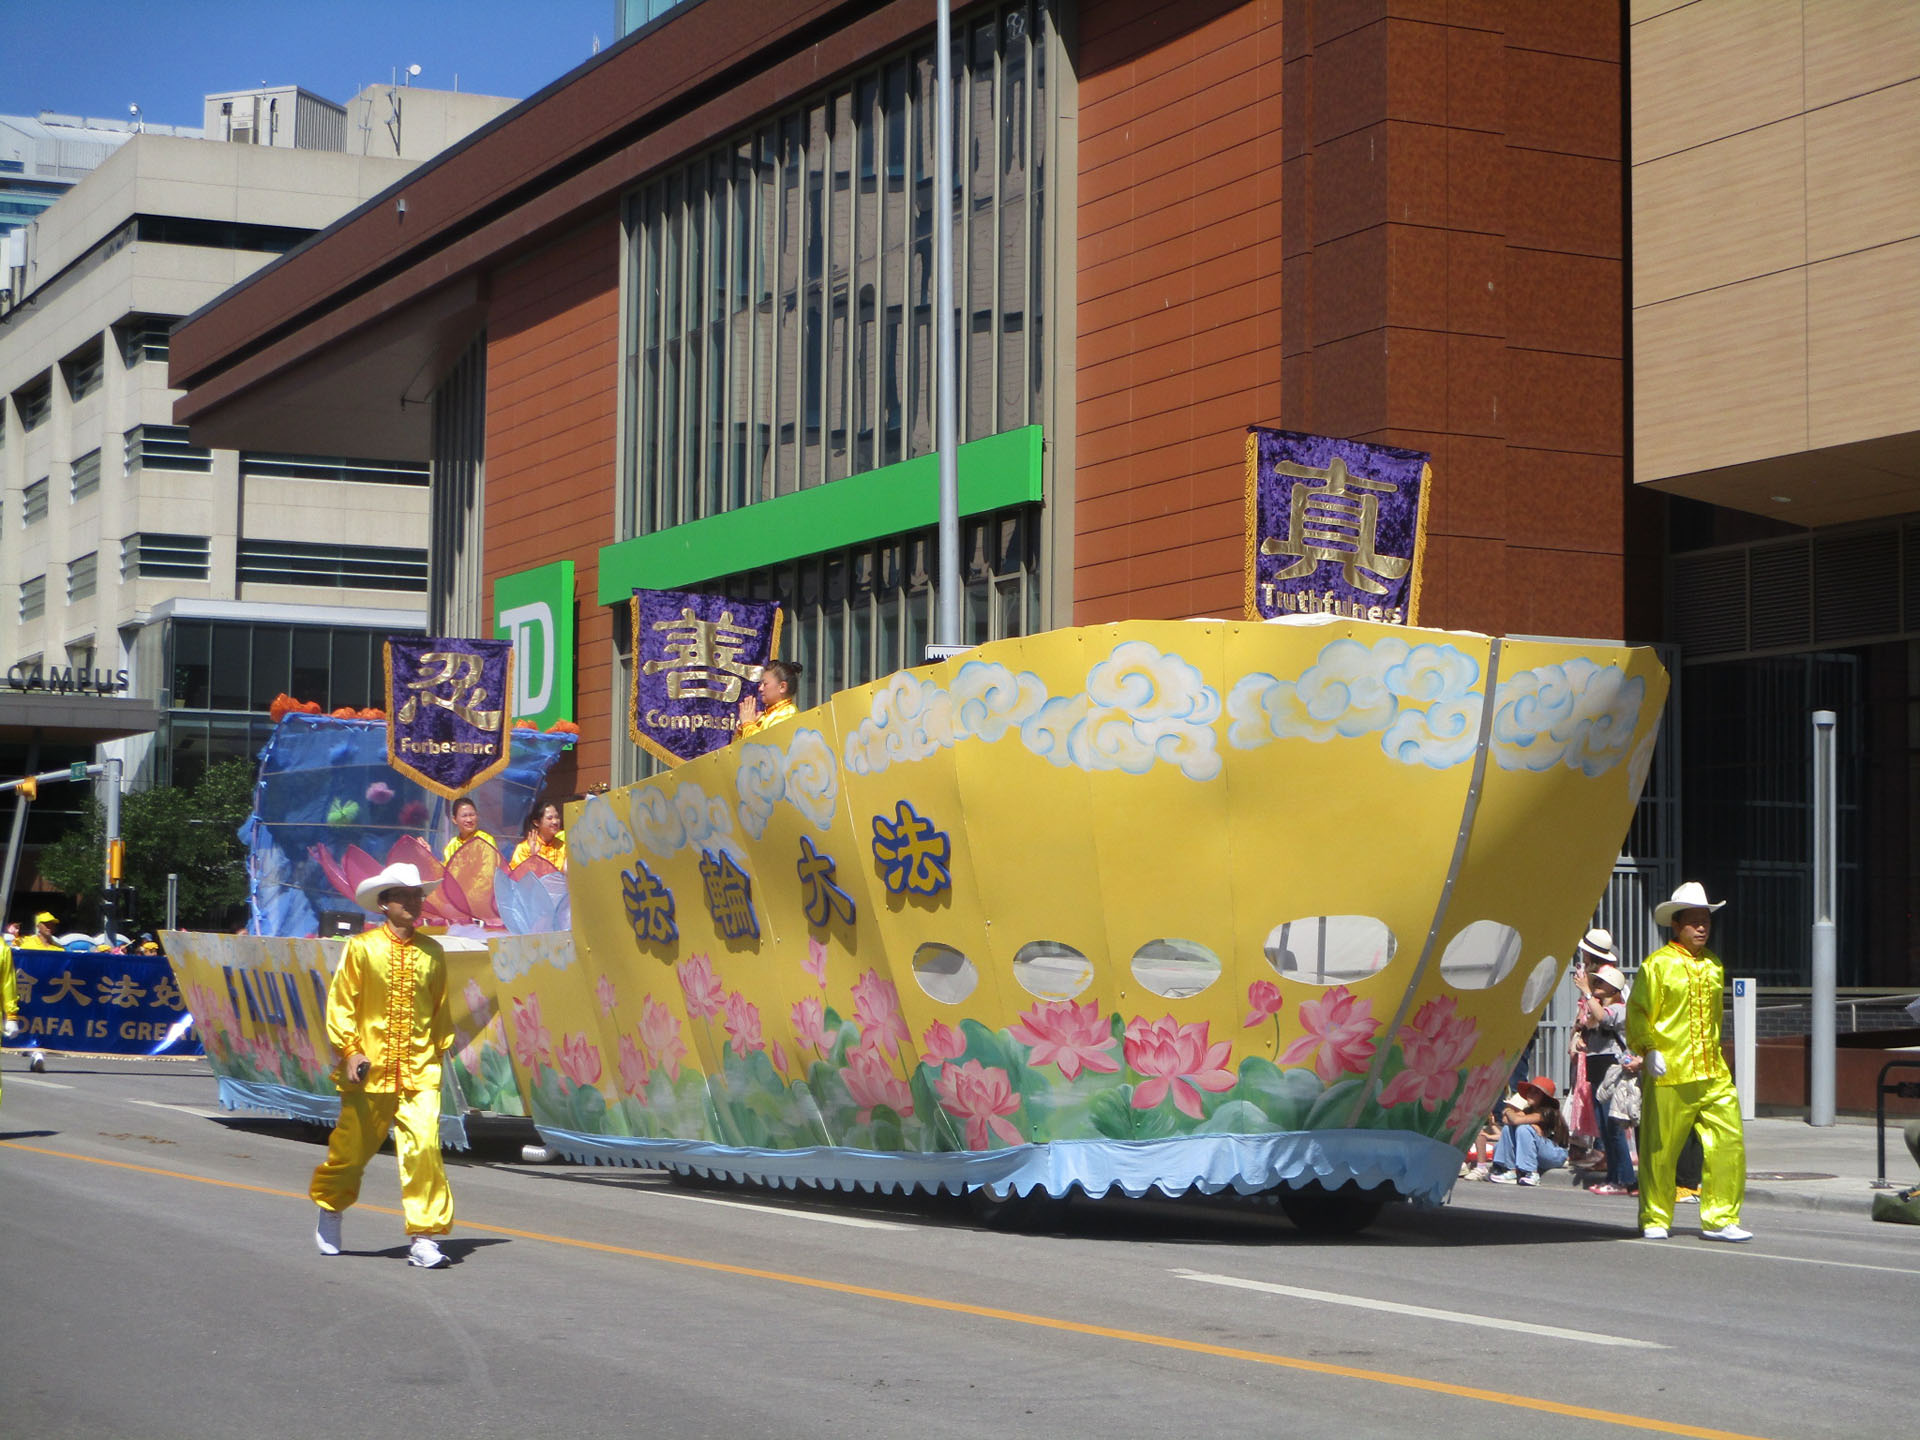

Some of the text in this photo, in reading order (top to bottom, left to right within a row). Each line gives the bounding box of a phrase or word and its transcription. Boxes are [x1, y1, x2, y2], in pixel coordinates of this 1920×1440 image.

[1260, 457, 1411, 595] 真
[7, 664, 130, 692] CAMPUS
[398, 652, 502, 732] 忍
[500, 602, 554, 717] TD
[642, 608, 764, 703] 善
[86, 1020, 108, 1038] IS
